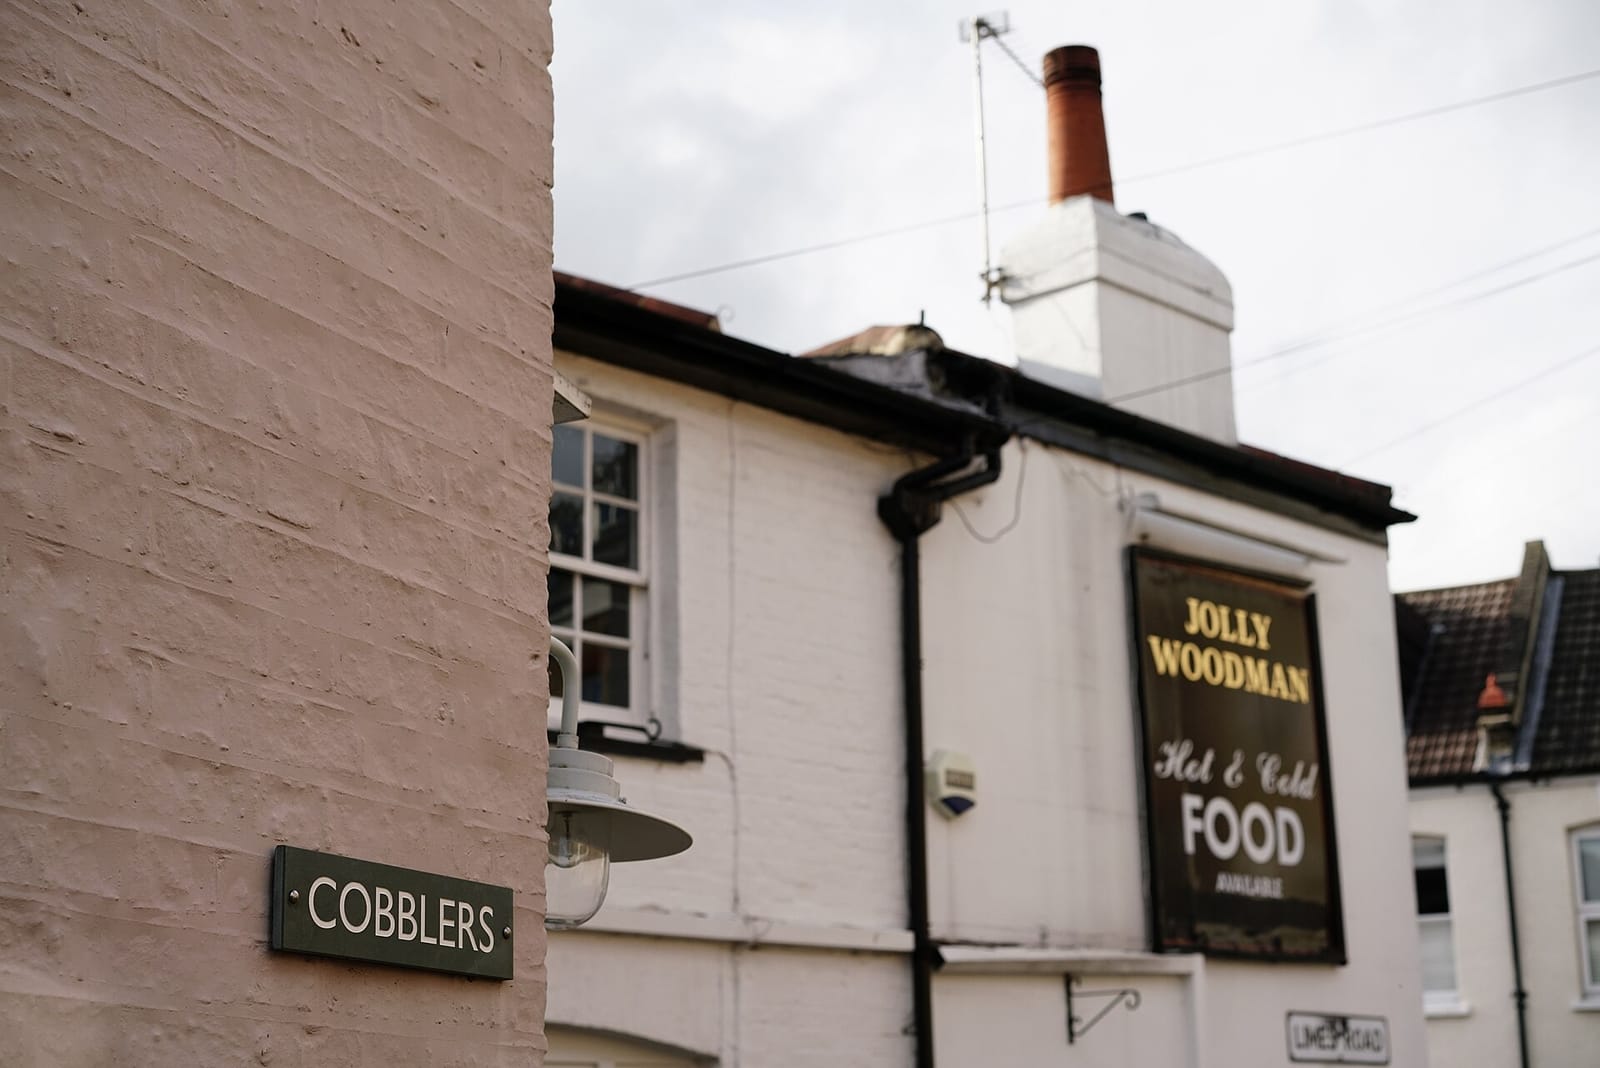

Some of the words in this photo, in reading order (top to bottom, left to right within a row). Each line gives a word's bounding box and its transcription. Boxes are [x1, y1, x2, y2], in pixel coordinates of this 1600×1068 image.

[1184, 597, 1271, 650] JOLLY
[1148, 635, 1309, 704] WOODMAN
[1154, 739, 1215, 784] Hot
[1223, 749, 1244, 789] &
[1256, 752, 1318, 799] Cold
[1181, 793, 1305, 867] FOOD
[308, 876, 495, 953] COBBLERS
[1215, 871, 1283, 898] AVAILABLE
